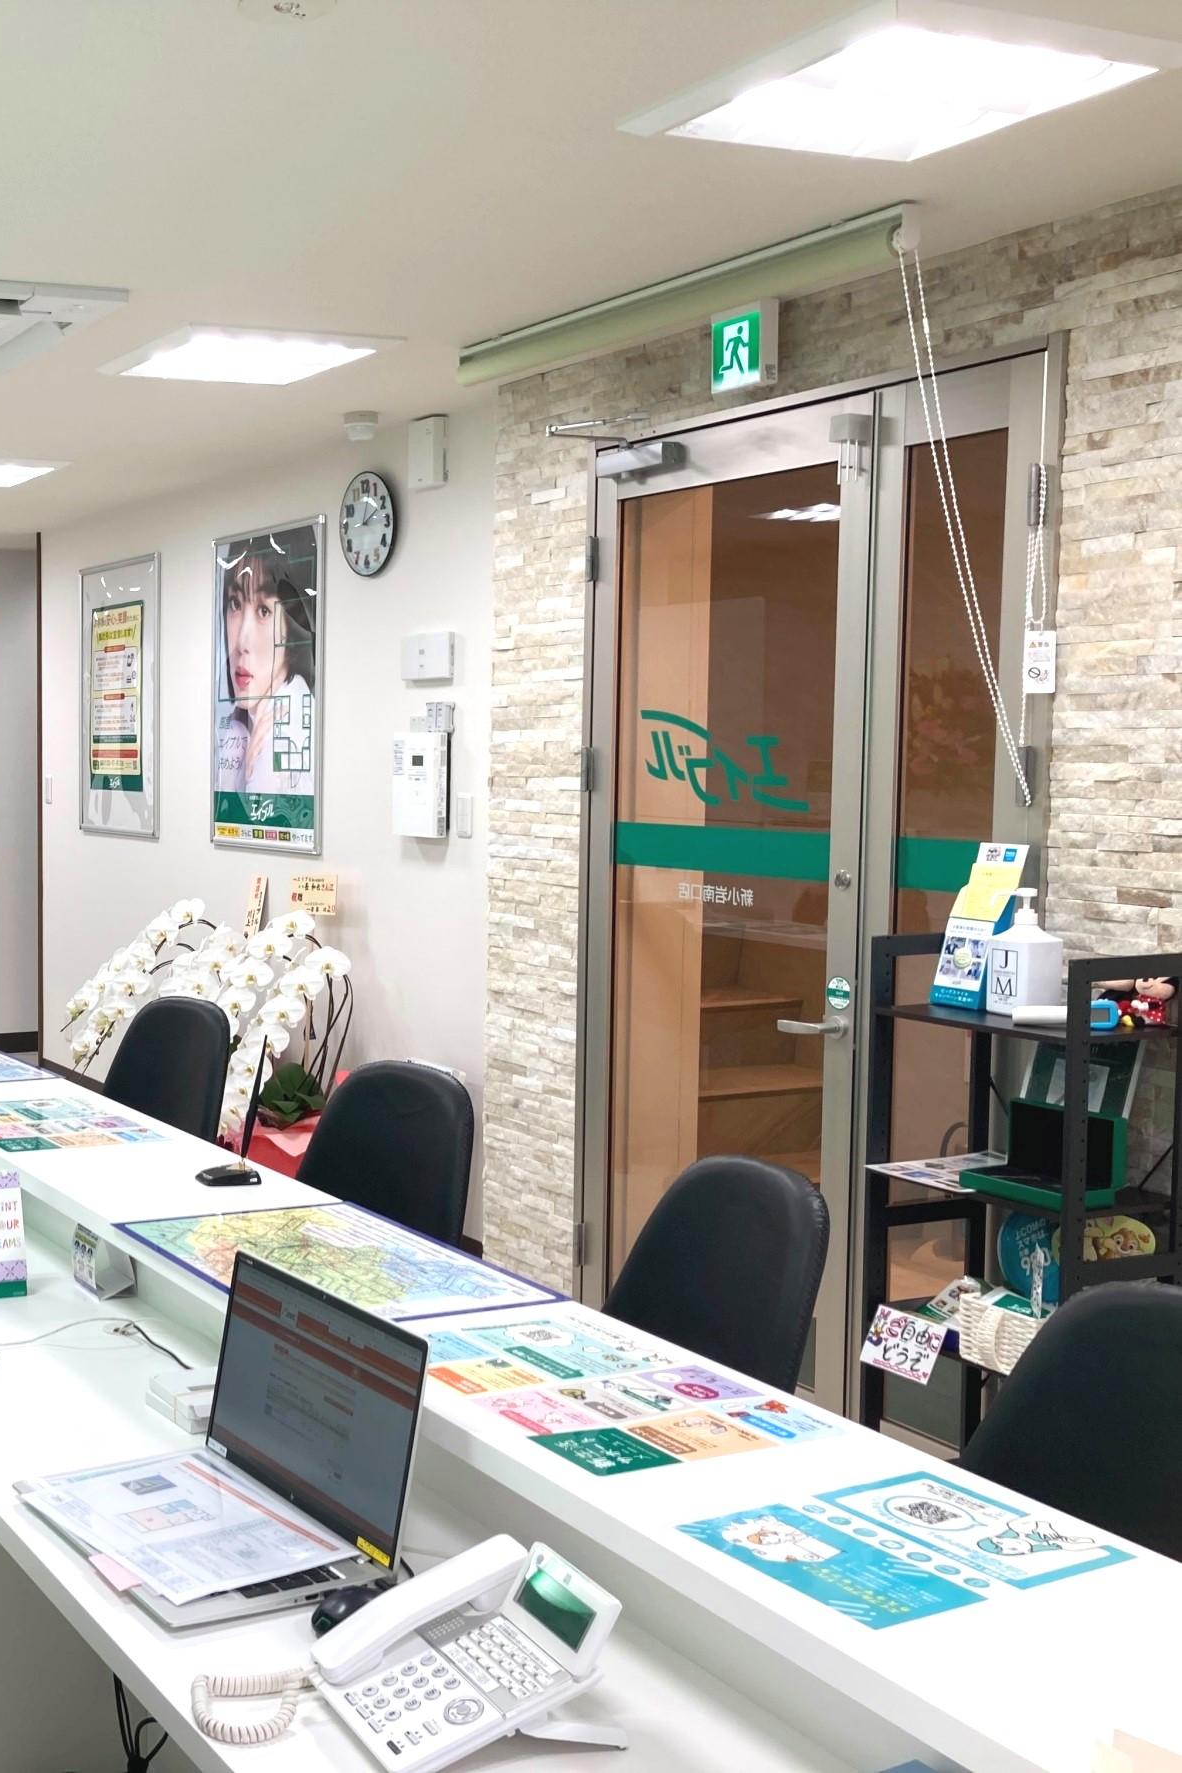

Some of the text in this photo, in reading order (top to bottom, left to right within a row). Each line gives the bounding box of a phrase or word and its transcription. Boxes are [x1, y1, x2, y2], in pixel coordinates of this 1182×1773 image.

[360, 479, 370, 494] 12
[372, 482, 378, 497] 1
[380, 495, 386, 510] 2
[345, 504, 355, 518] 10
[384, 514, 391, 528] 3
[380, 533, 387, 548] 4
[354, 551, 360, 565] 7
[364, 555, 370, 569] 6
[373, 548, 380, 562] 5
[250, 799, 275, 822] エイブル
[994, 976, 1013, 997] M
[885, 1315, 943, 1353] ご自由に
[882, 1343, 930, 1372] どうぞ
